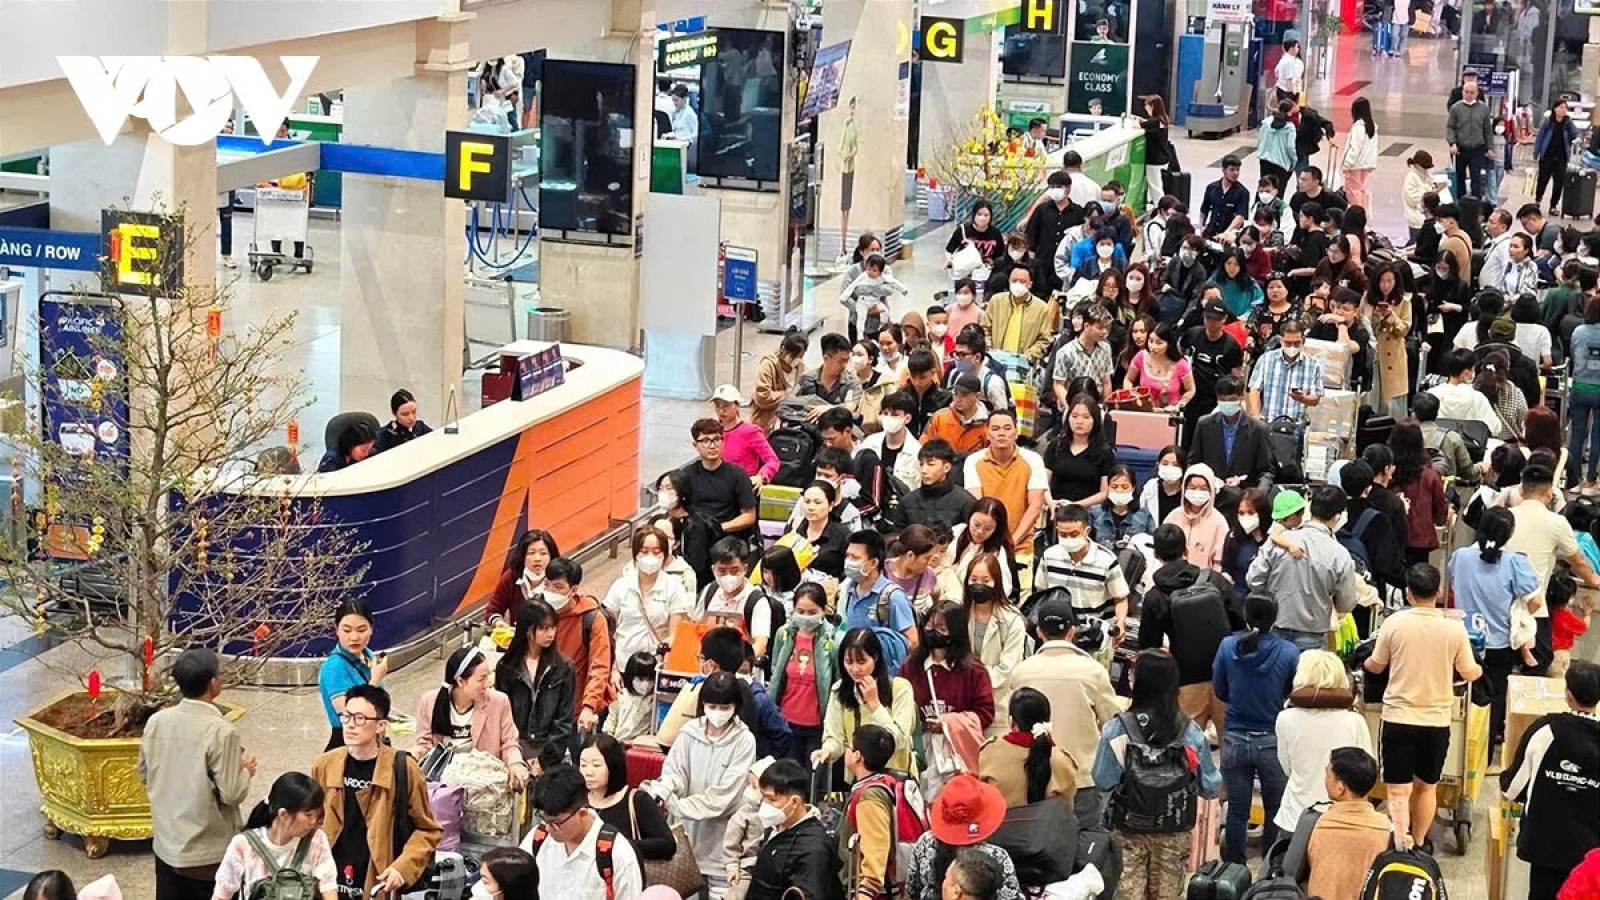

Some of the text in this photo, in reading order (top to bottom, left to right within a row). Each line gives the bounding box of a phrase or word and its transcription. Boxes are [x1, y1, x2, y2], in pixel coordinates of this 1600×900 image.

[1027, 0, 1053, 30] H
[926, 22, 957, 58] G
[1079, 72, 1119, 83] ECONOMY
[1084, 83, 1112, 92] CLASS
[459, 142, 494, 190] F
[45, 245, 81, 261] ROW
[118, 223, 160, 285] E
